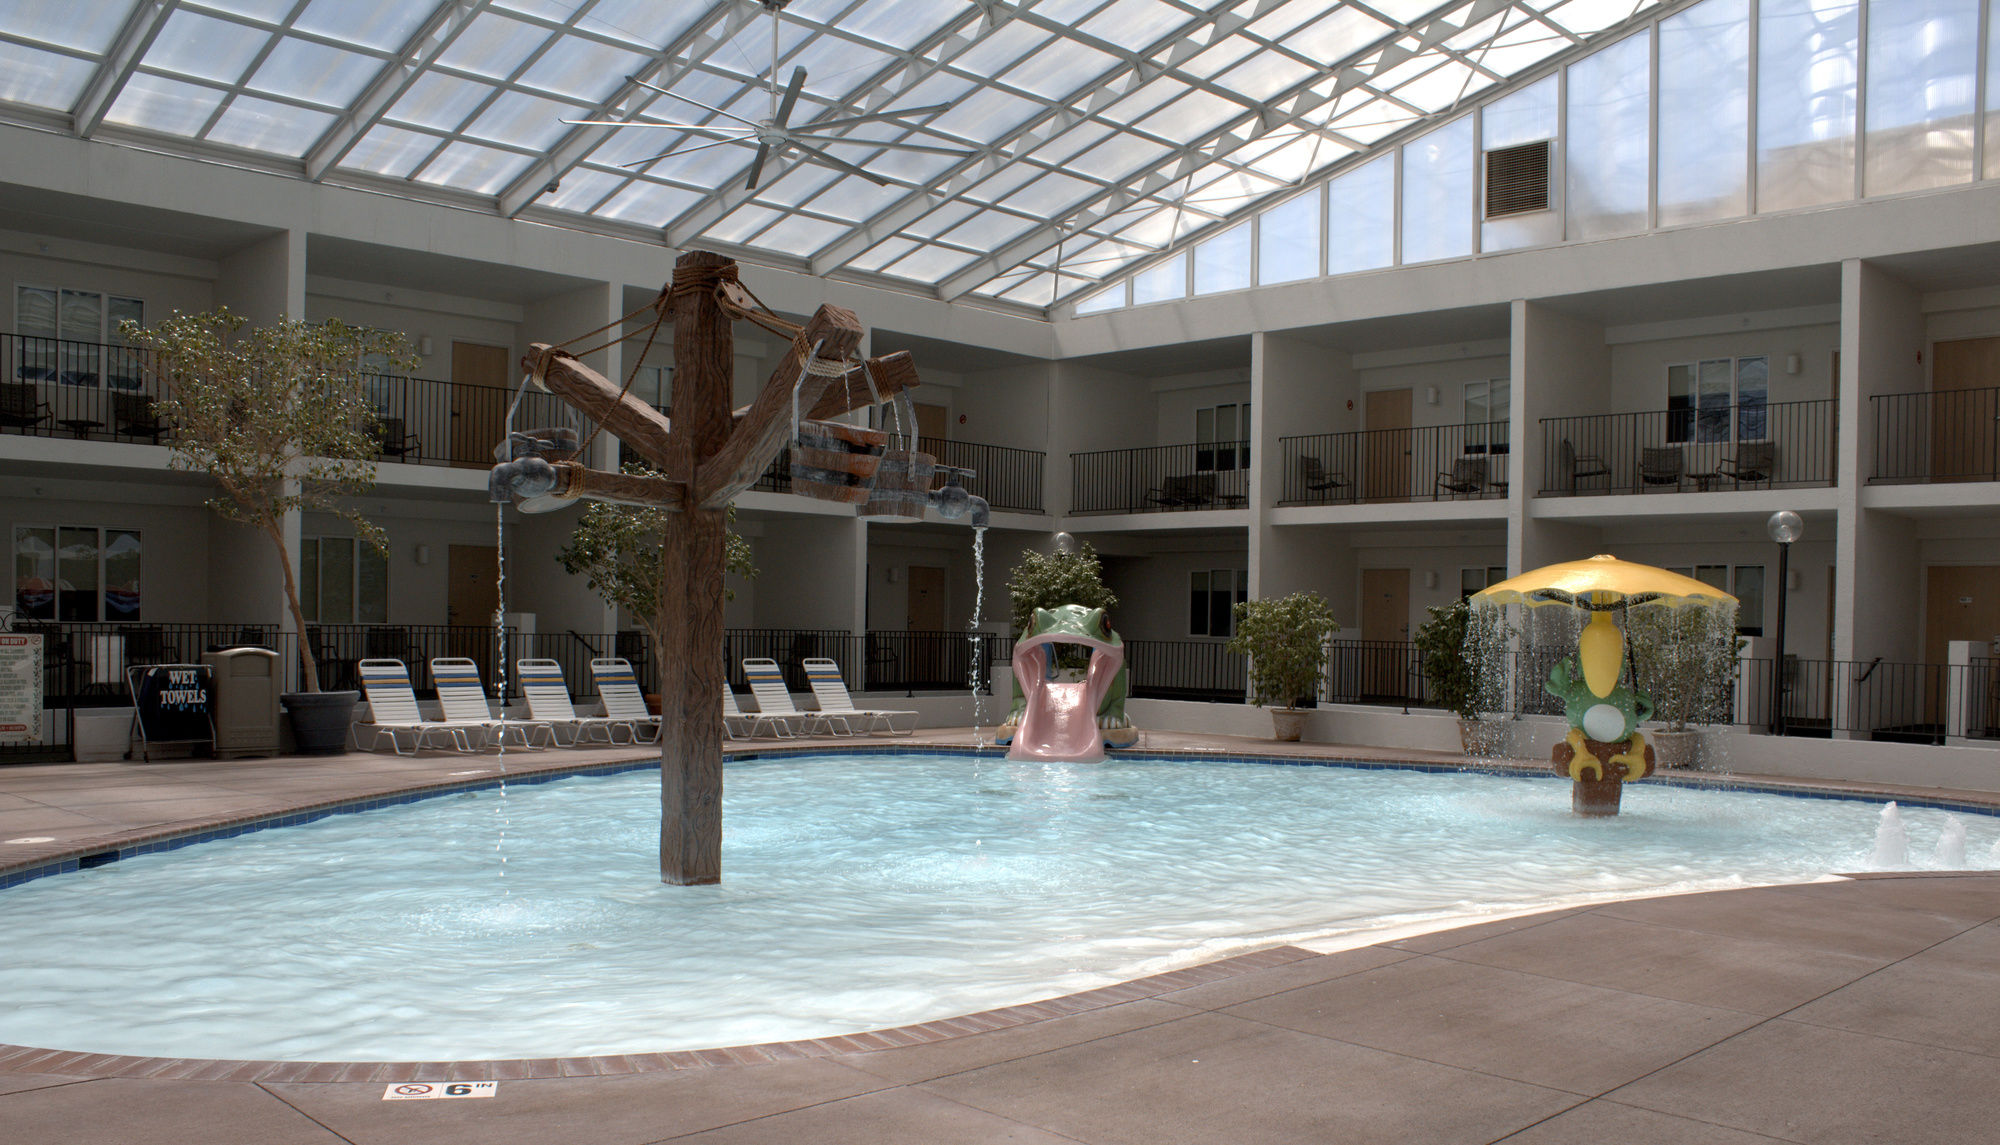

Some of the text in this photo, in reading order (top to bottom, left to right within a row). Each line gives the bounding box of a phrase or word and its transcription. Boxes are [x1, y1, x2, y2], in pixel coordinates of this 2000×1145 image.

[169, 670, 197, 684] WET
[160, 689, 207, 704] TOWELS
[446, 1084, 473, 1096] 6
